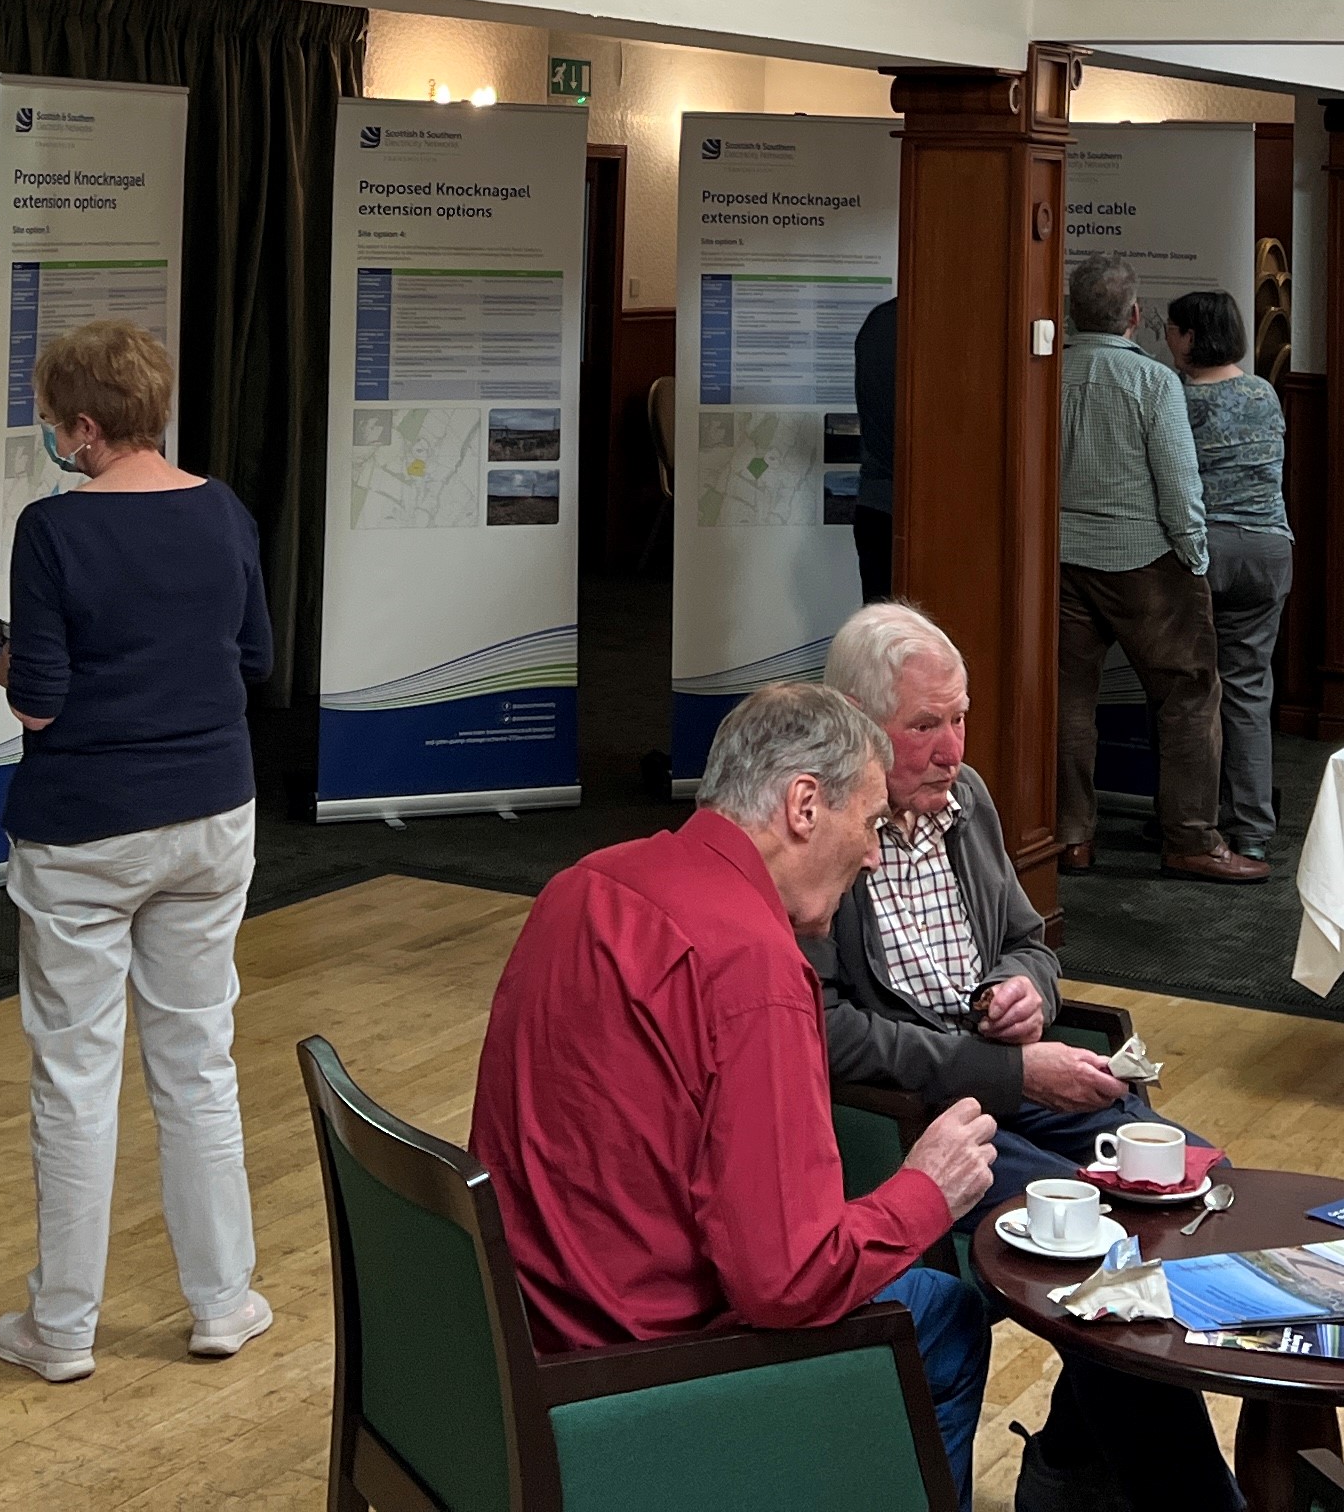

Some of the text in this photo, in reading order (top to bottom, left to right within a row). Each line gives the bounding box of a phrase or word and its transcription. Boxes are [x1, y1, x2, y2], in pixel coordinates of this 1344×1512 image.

[37, 111, 60, 121] Scottish
[67, 113, 95, 123] Southern
[384, 129, 418, 138] Scottish
[426, 131, 462, 140] Southern
[763, 143, 796, 152] Southern
[1087, 152, 1122, 160] Southern
[14, 169, 145, 190] Proposed Knocknagael
[359, 180, 531, 200] Proposed Knocknagael
[13, 194, 117, 212] extension options
[702, 190, 860, 209] Proposed Knocknagael
[358, 204, 492, 220] extension options
[1097, 202, 1136, 215] cable
[701, 212, 824, 228] extension options
[1066, 223, 1122, 237] options
